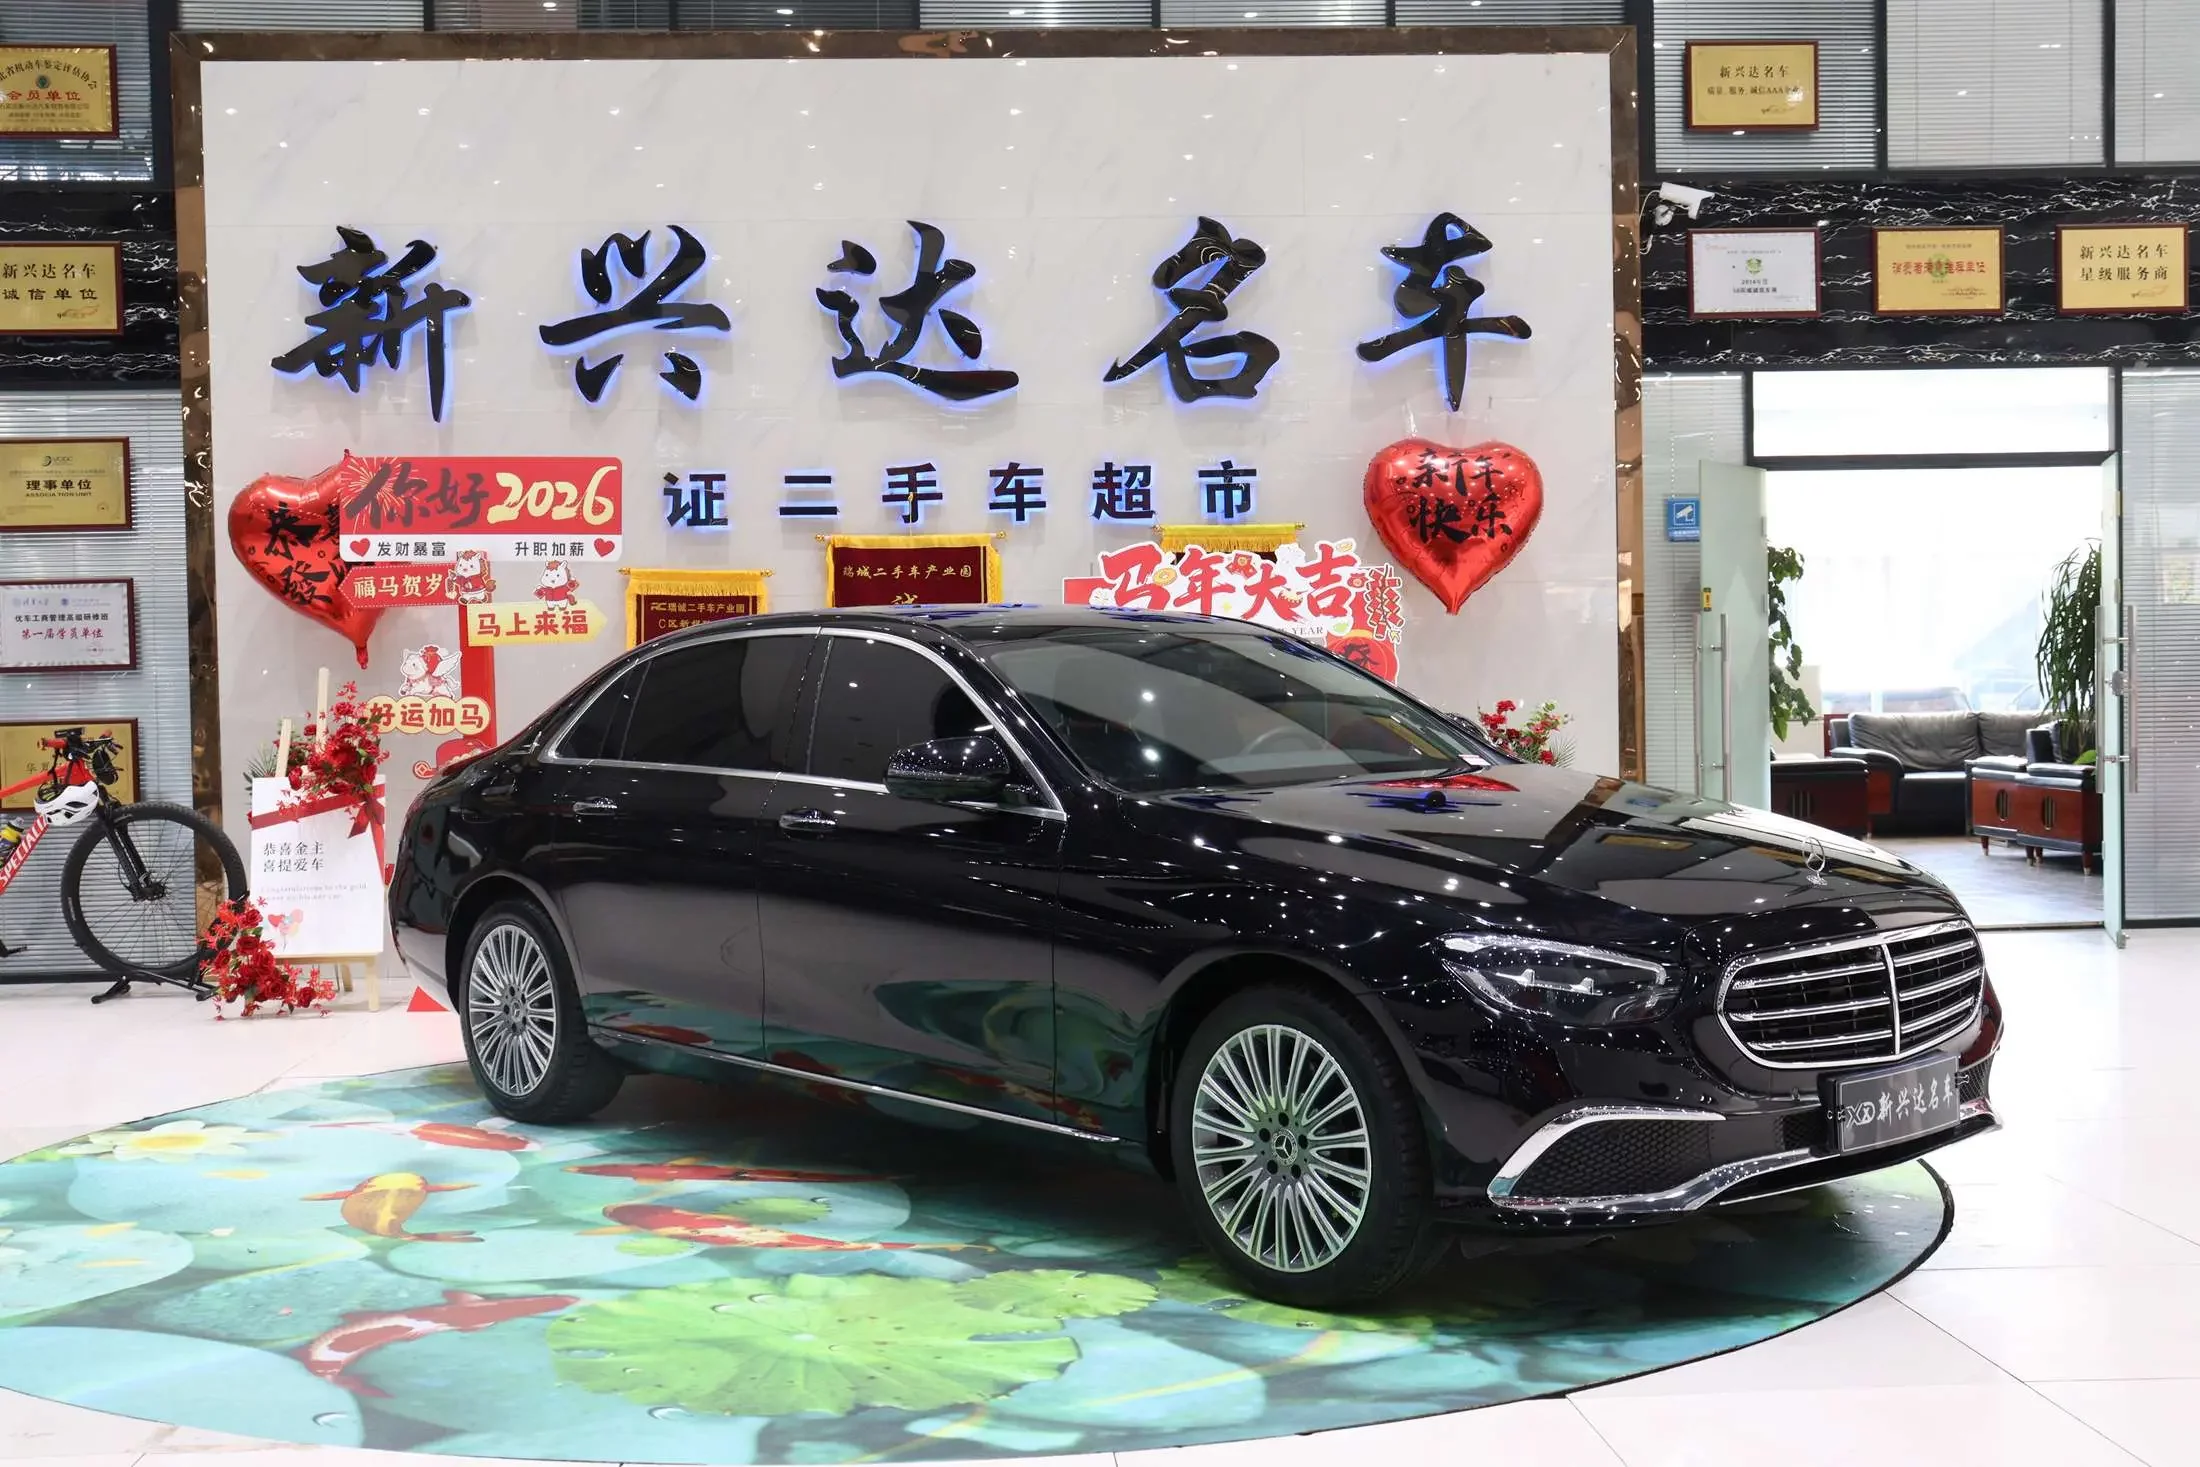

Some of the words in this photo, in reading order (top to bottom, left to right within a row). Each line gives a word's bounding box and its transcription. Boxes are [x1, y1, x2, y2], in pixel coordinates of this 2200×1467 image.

[1720, 65, 1789, 78] 新兴达名车
[7, 90, 81, 102] 会员单位
[2080, 244, 2168, 260] 新兴达名车
[3, 263, 96, 279] 新兴达名车
[2080, 266, 2168, 281] 星级服务商
[2, 288, 98, 300] 诚信单位
[270, 212, 1533, 422] 新兴达名车
[1412, 448, 1504, 496] 新年
[26, 479, 91, 491] 理事单位
[345, 462, 489, 530] 你好
[486, 465, 618, 526] 2026
[664, 461, 1258, 528] 证二手车超市
[1409, 494, 1513, 544] 快乐
[377, 541, 447, 557] 发财暴富
[515, 541, 585, 557] 升职加薪
[353, 574, 444, 599] 福马贺岁
[1101, 544, 1358, 621] 马年大吉
[477, 610, 589, 637] 马上来福
[1291, 626, 1324, 635] YEAR
[22, 626, 104, 640] 第一届学员单位
[370, 702, 484, 729] 好运加马
[263, 841, 325, 856] 恭喜金主
[263, 858, 325, 873] 喜提爱车
[1877, 1073, 1954, 1127] 新兴达名车
